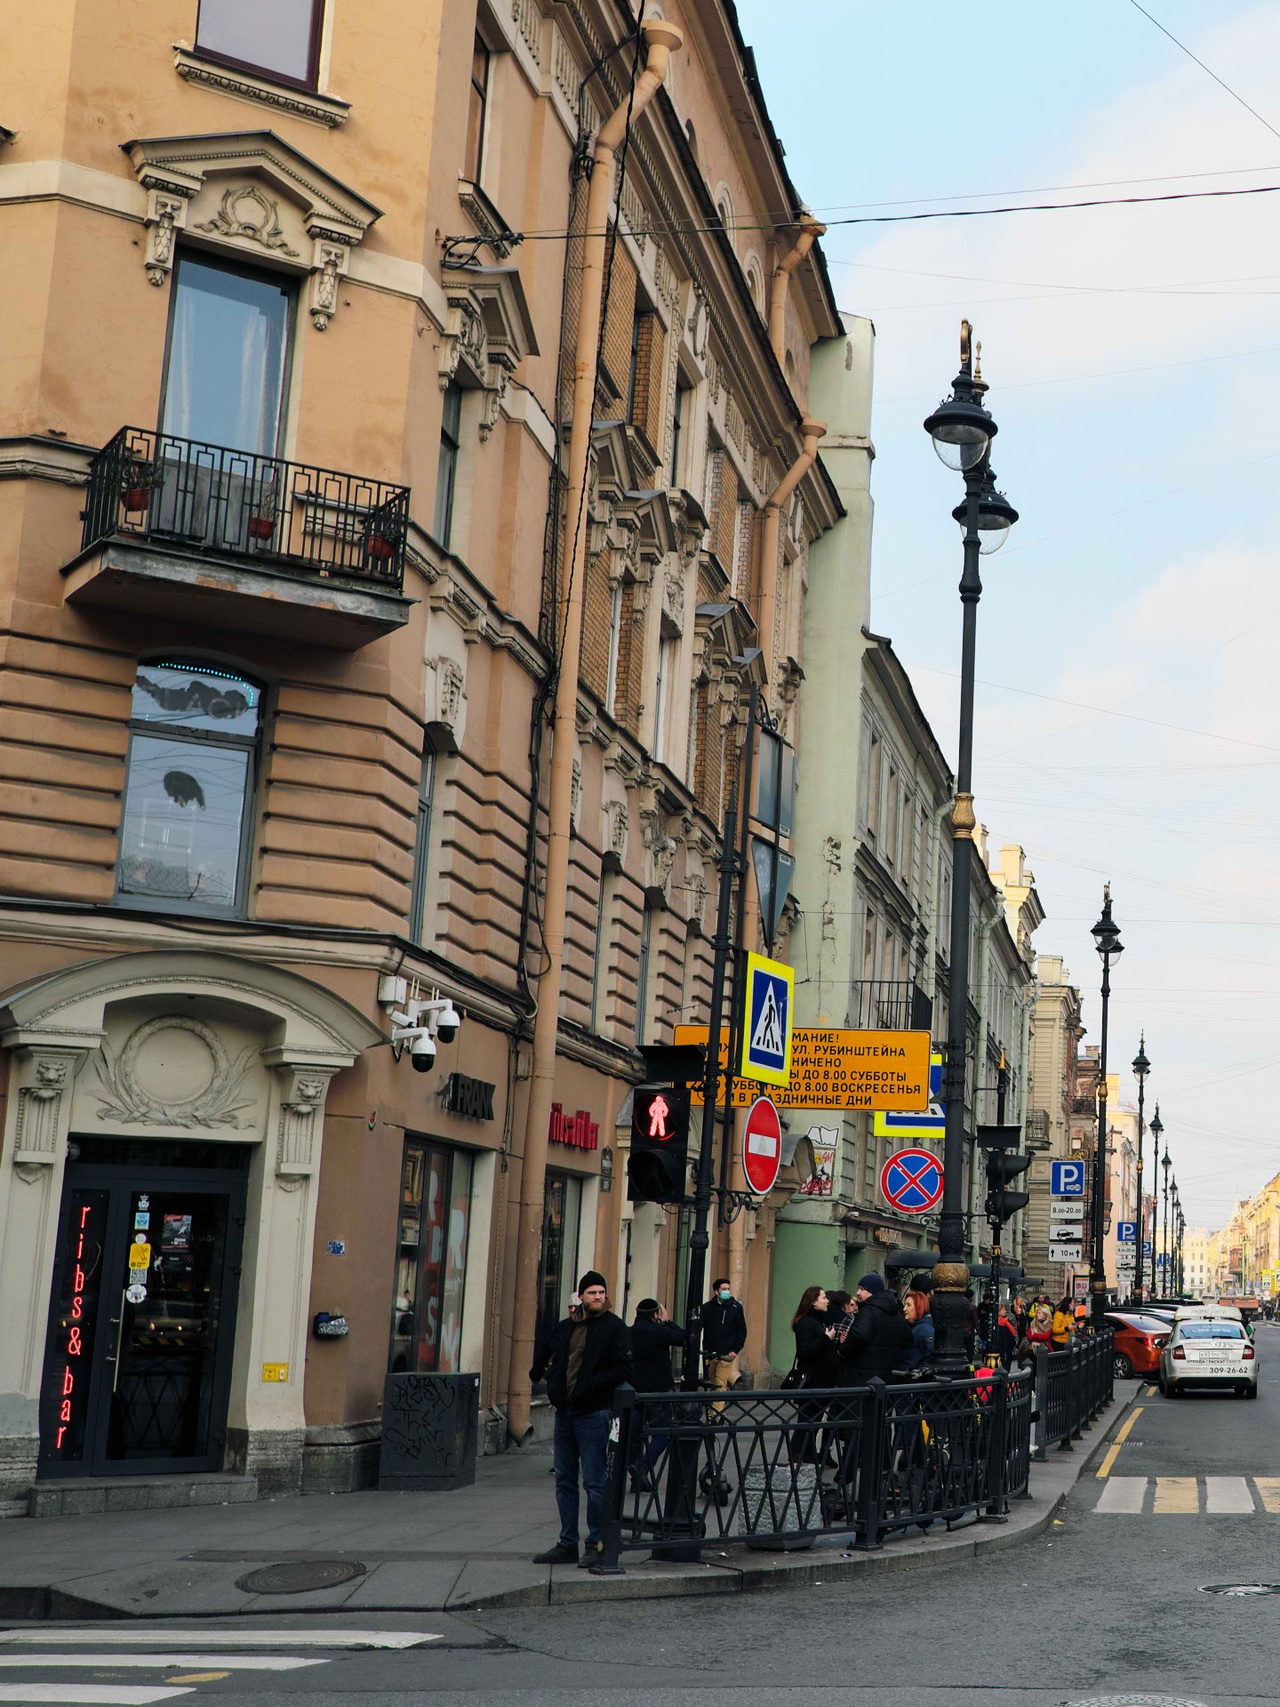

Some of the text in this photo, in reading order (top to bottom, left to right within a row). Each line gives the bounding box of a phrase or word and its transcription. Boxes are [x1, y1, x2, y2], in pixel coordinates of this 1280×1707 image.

[792, 1033, 840, 1043] МАНИЕ!
[814, 1045, 906, 1057] РУБИНШТЕЙНА
[792, 1057, 842, 1067] НИЧЕНО
[802, 1070, 907, 1081] ДО 8.00 СУББОТЫ
[732, 1080, 783, 1092] УББОТЫ
[804, 1082, 829, 1092] 8.00
[832, 1083, 921, 1094] ВОСКРЕСЕНЬЯ
[454, 1073, 496, 1120] FRANK
[751, 1093, 842, 1105] ПАЗДНИЧНЫЕ
[846, 1095, 872, 1107] ДНИ
[56, 1206, 91, 1449] ribs & bar
